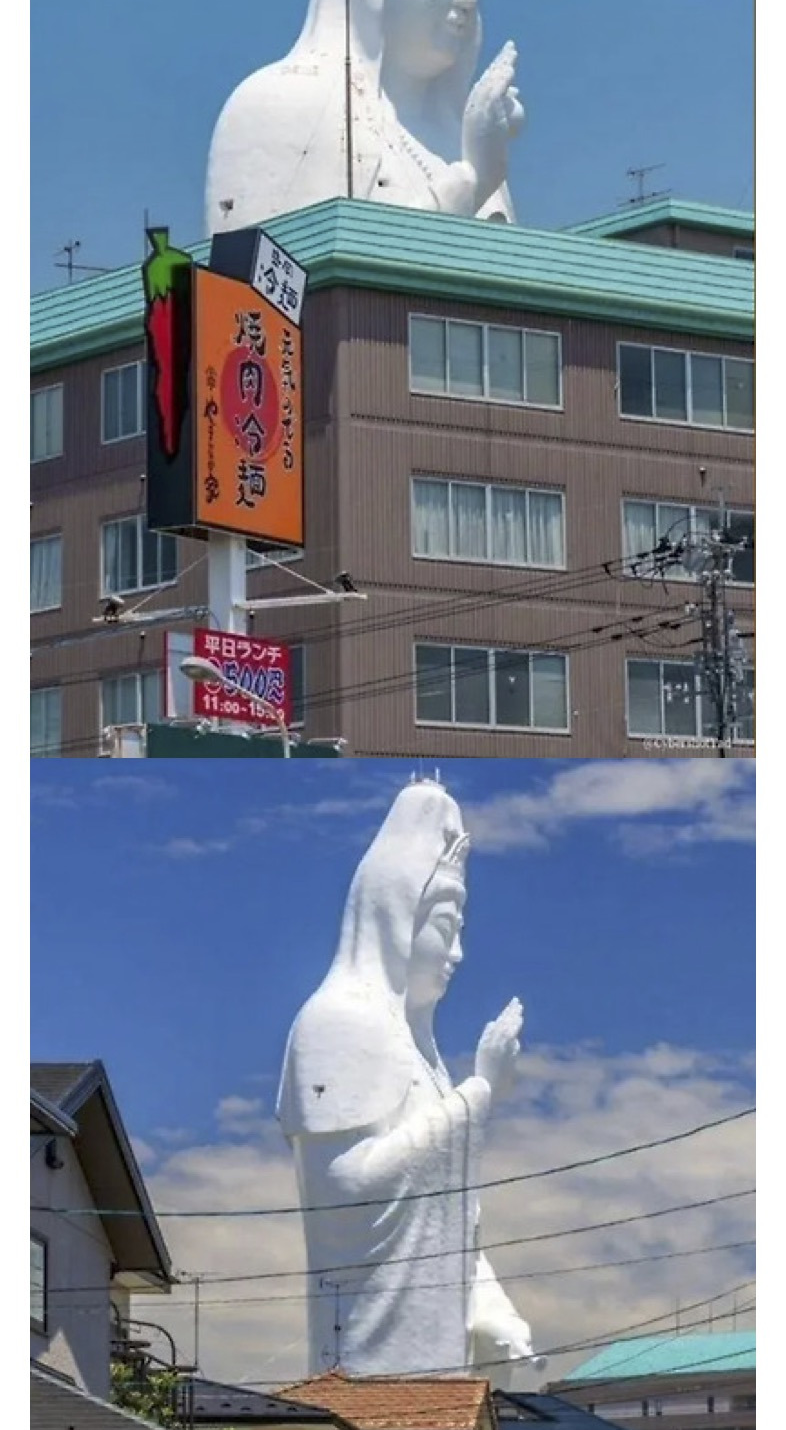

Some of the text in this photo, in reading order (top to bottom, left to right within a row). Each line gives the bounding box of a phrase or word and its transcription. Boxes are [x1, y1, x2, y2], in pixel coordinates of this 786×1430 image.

[204, 634, 282, 664] 平日ランチ
